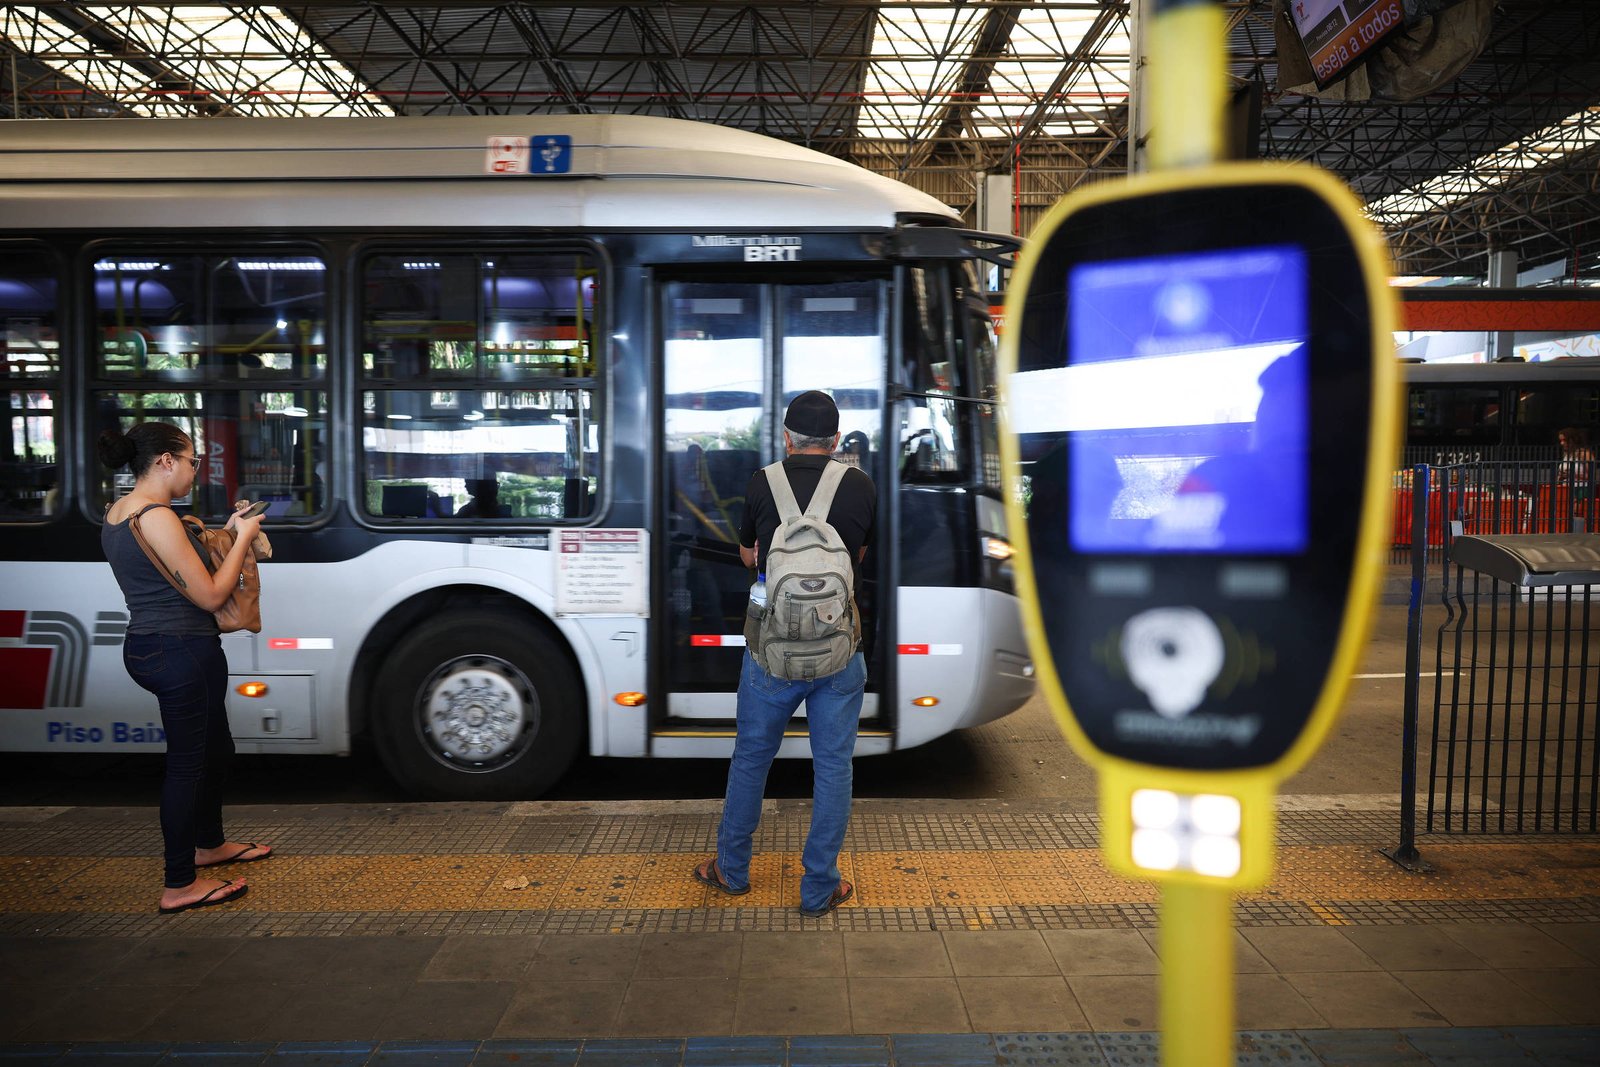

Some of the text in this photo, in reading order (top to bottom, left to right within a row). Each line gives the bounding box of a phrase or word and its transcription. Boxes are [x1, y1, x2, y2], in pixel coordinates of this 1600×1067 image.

[1349, 36, 1361, 53] a
[1359, 2, 1401, 44] todos
[691, 234, 802, 247] Millennium
[743, 246, 802, 262] BRT
[46, 721, 166, 743] Piso Baix
